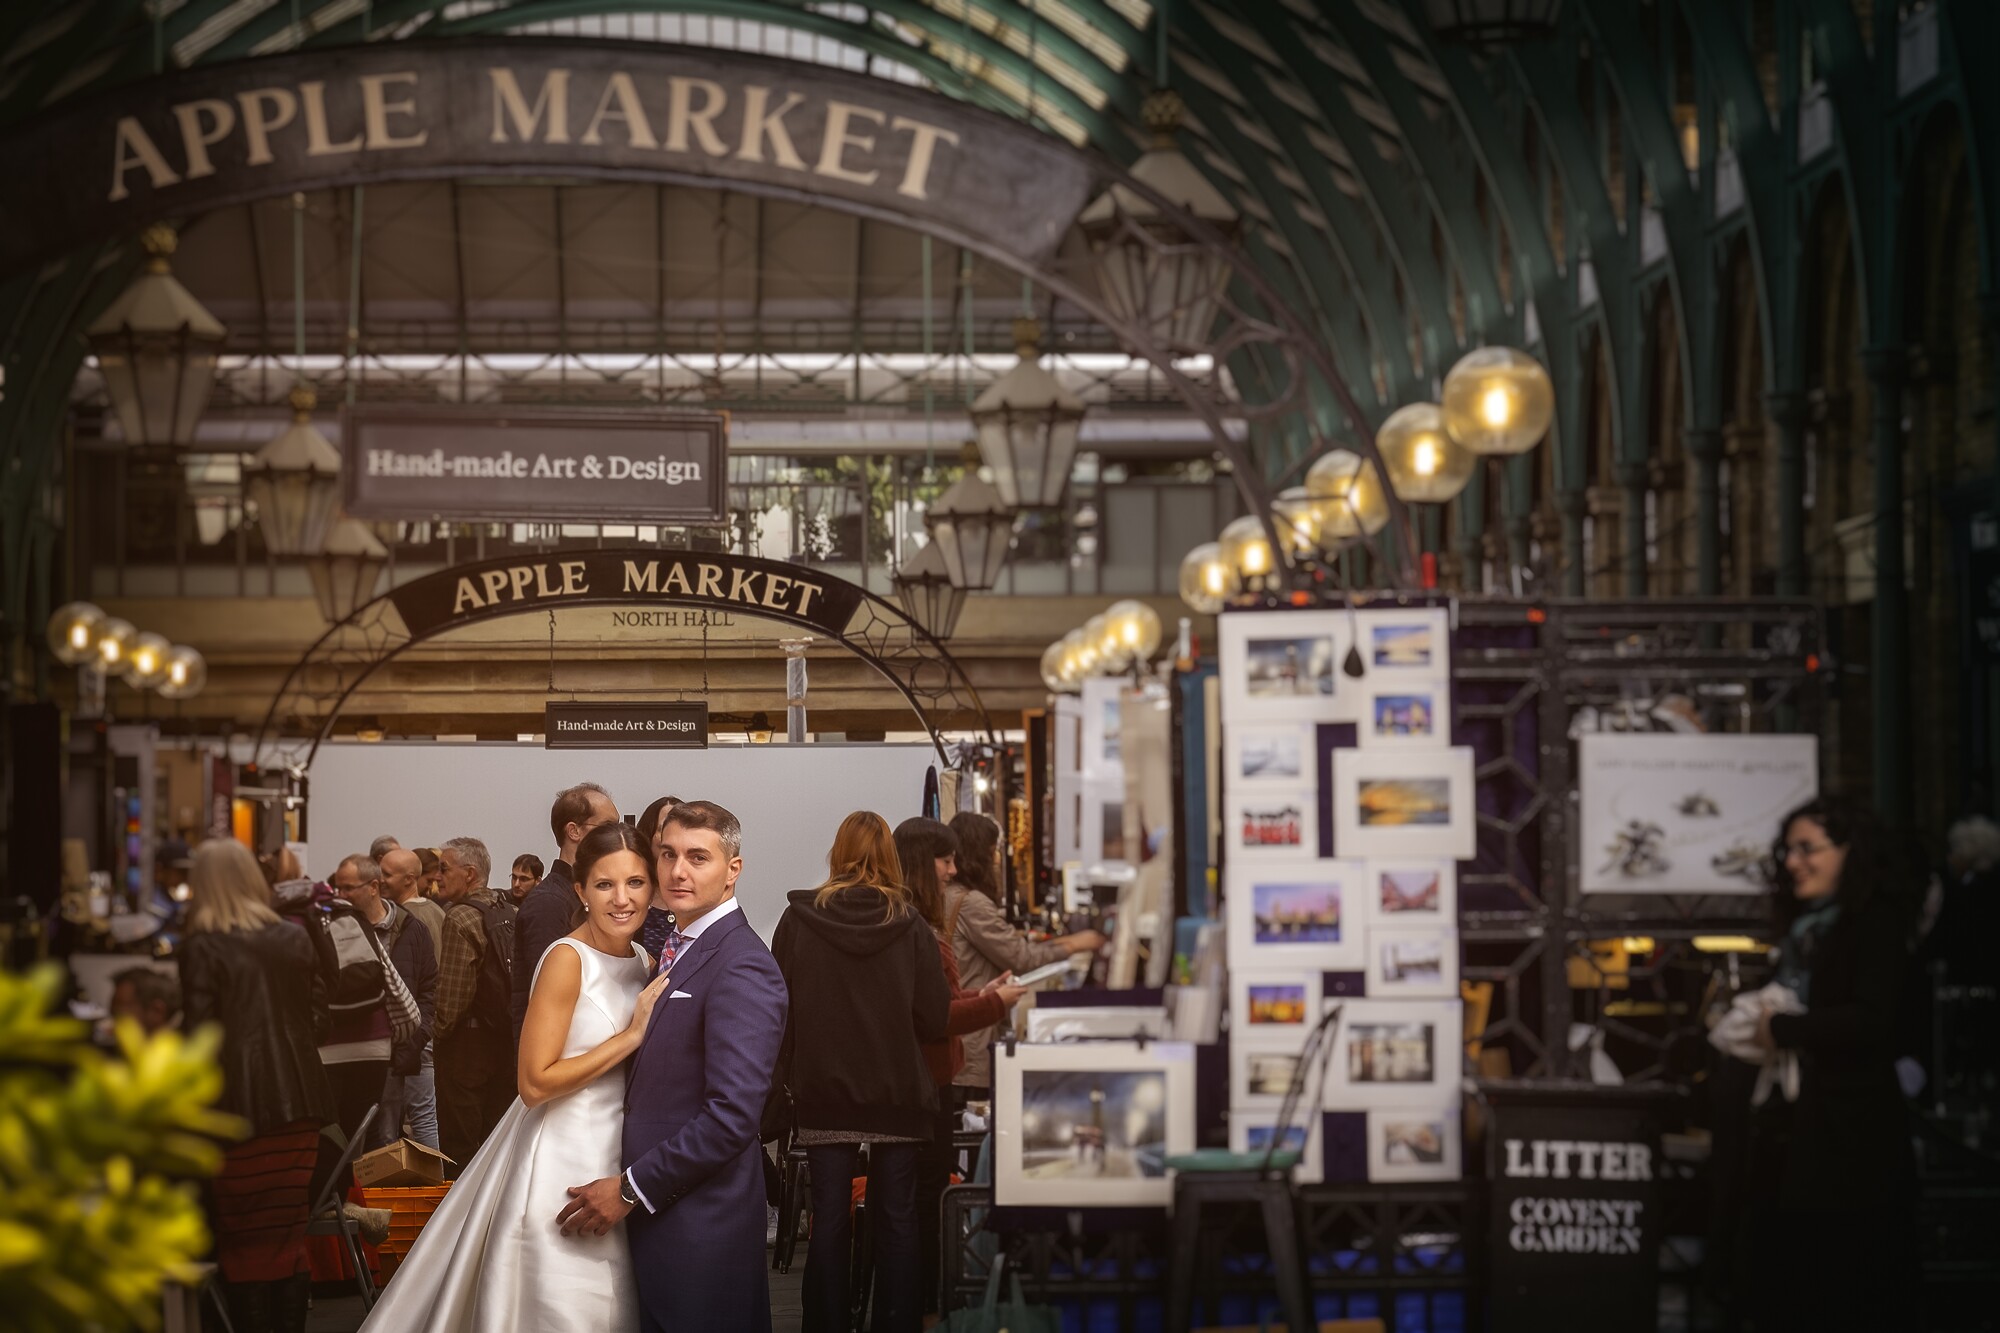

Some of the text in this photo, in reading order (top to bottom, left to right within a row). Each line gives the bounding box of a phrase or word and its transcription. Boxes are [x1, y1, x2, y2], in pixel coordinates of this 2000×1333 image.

[108, 67, 959, 201] APPLE MARKET
[367, 448, 702, 485] Hand-made Art & Design
[452, 560, 823, 617] APPLE MARKET
[612, 611, 735, 627] NORTH HALL
[556, 719, 696, 733] Hand-made Art & Design
[1504, 1138, 1653, 1181] LITTER
[1510, 1197, 1643, 1228] COVENT
[1509, 1224, 1642, 1254] GARDEN
